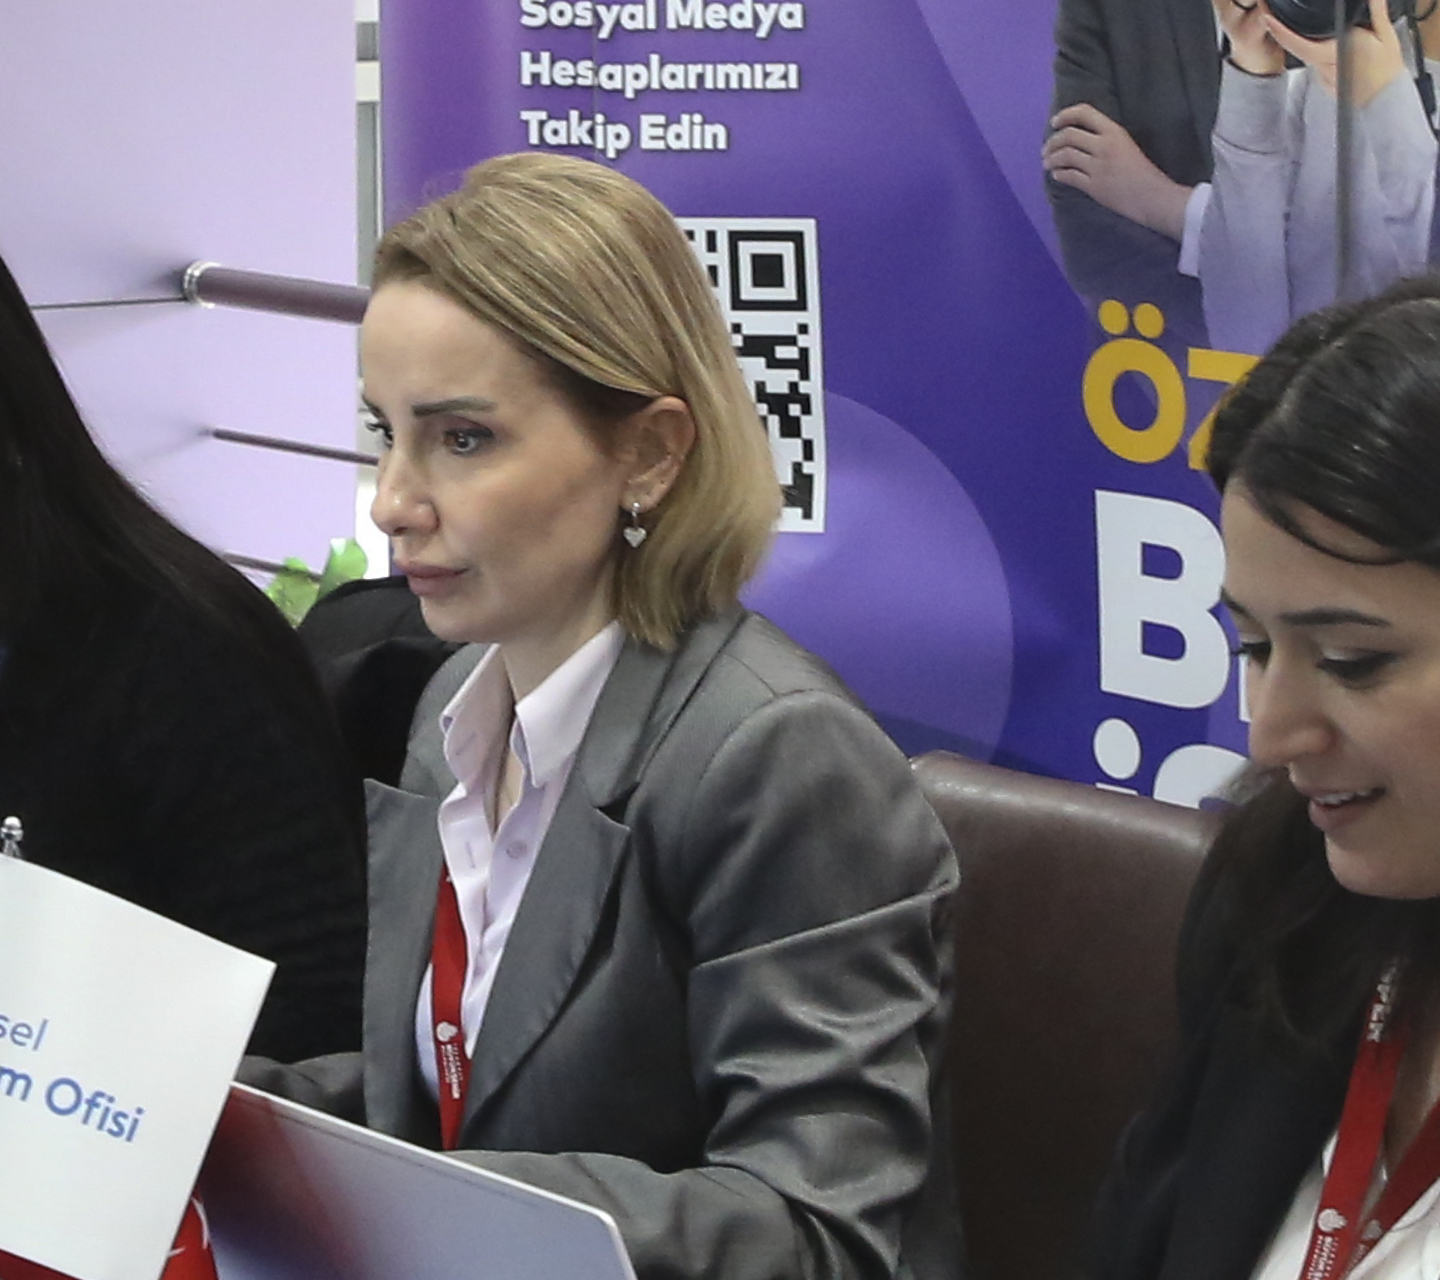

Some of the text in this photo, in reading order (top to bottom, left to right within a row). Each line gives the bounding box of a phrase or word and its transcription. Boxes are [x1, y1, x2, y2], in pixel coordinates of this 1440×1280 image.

[519, 50, 801, 99] Hesaplarımızı
[519, 110, 729, 159] Takip Edin
[1082, 299, 1265, 472] ÖZ
[44, 1076, 145, 1143] Ofisi
